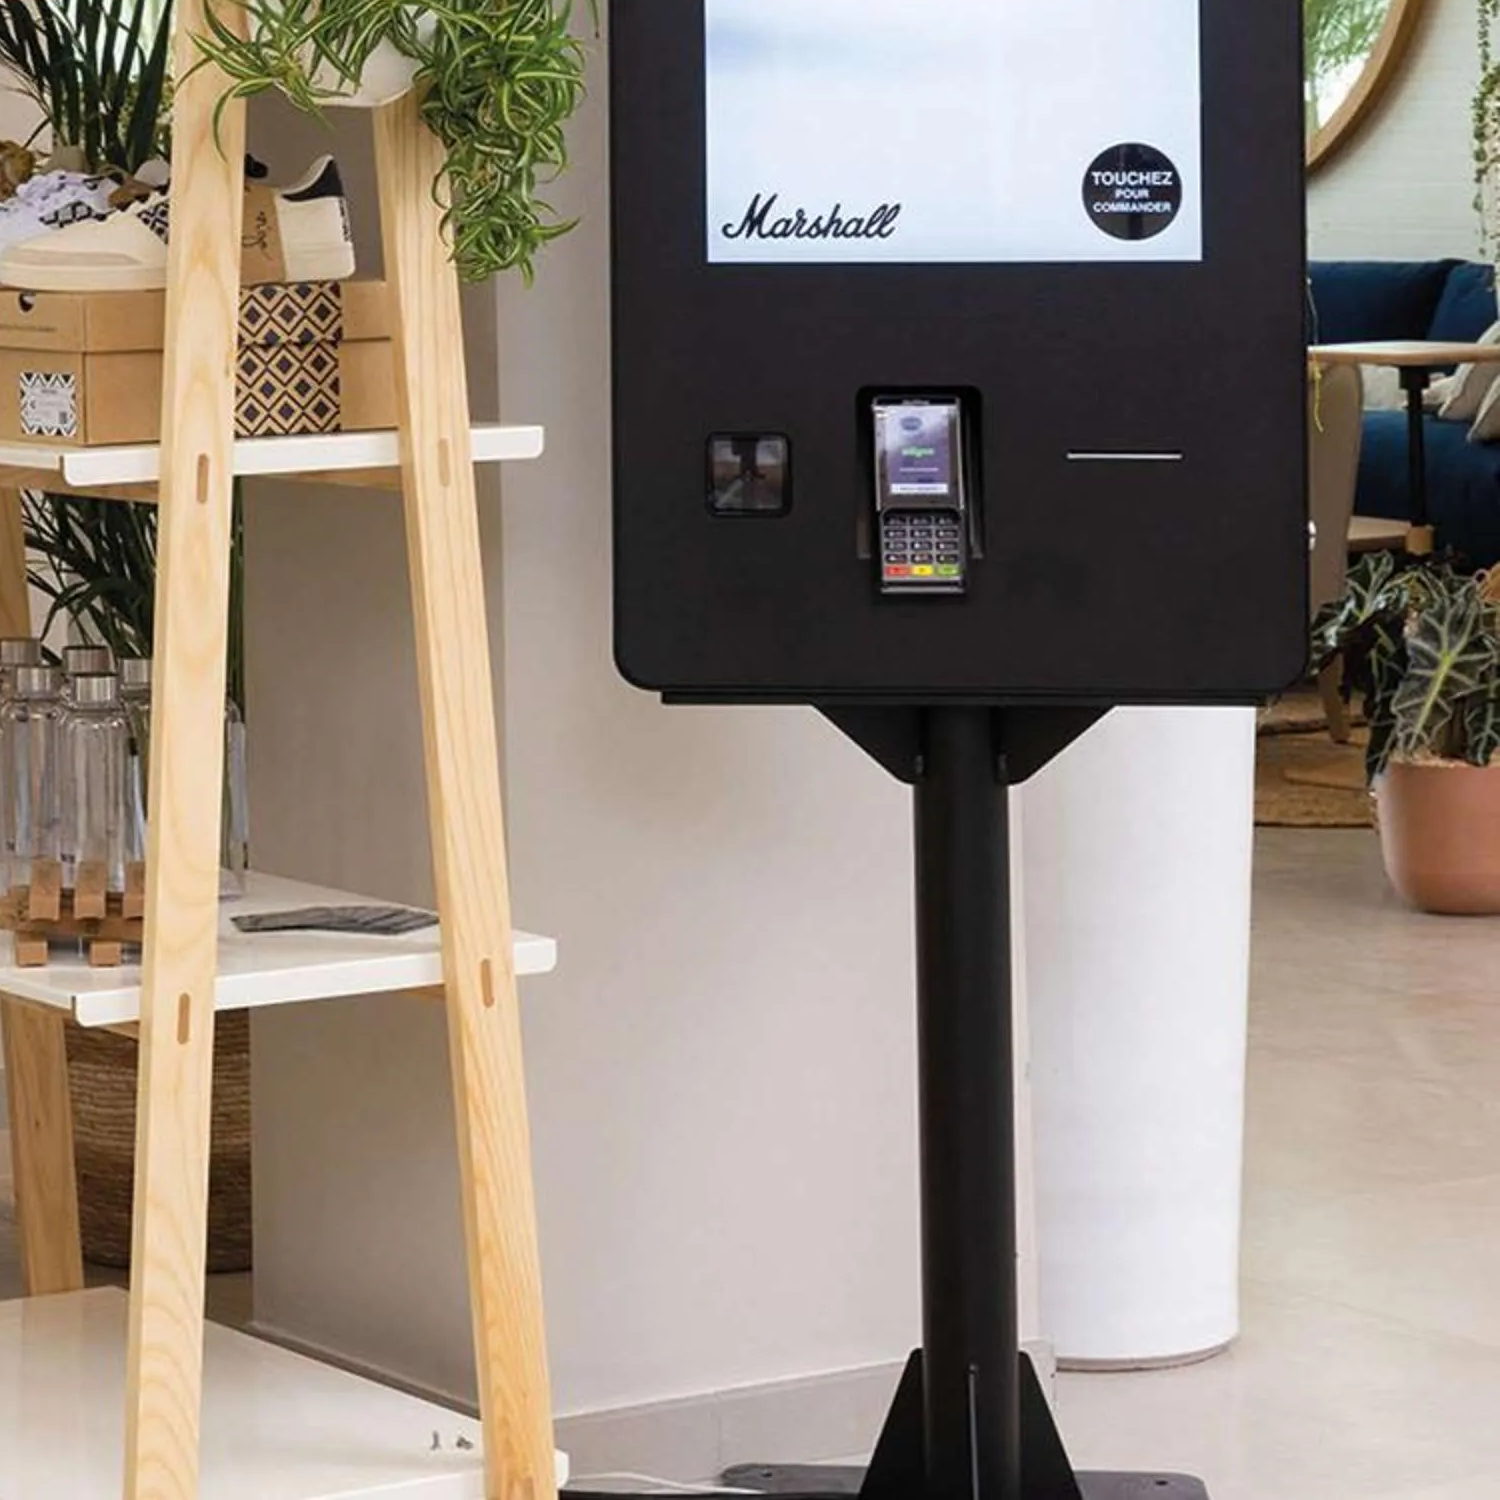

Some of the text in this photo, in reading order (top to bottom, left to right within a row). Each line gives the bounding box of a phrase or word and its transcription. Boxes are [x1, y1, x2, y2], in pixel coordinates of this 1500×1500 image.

[1091, 171, 1173, 186] TOUCHEZ
[1115, 188, 1149, 199] POUR
[1093, 202, 1172, 213] COMMANDER
[722, 193, 901, 239] Marshall
